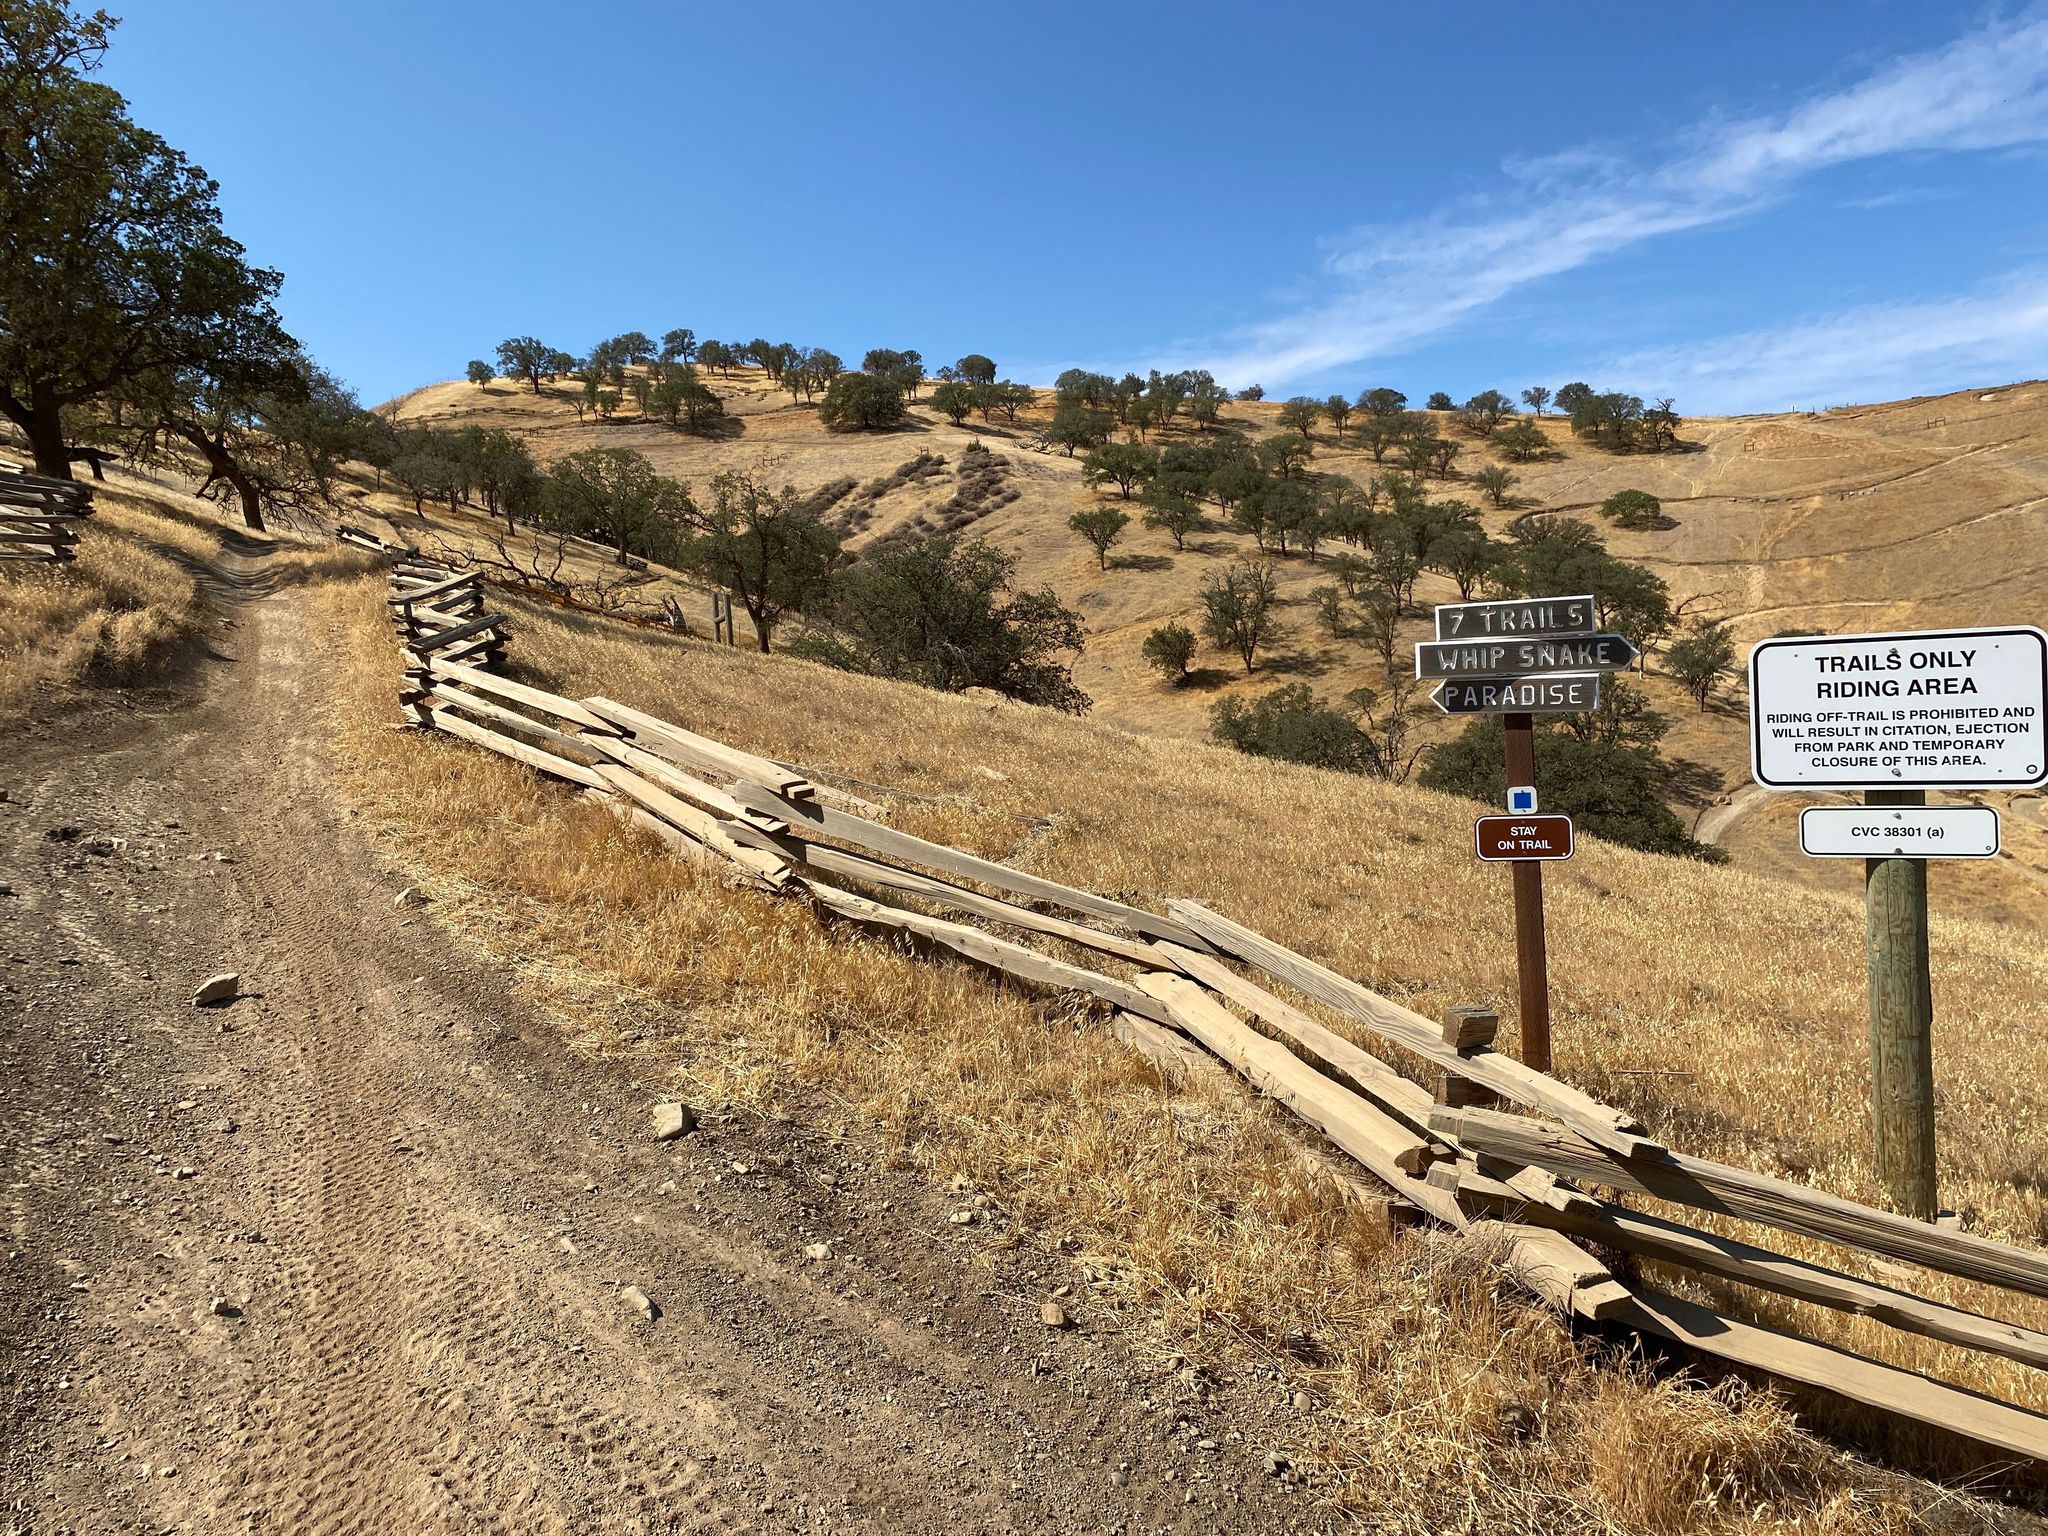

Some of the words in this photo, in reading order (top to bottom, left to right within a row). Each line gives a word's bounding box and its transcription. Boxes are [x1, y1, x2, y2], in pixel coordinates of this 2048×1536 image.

[1449, 612, 1464, 634] 7
[1480, 603, 1584, 632] TRAILS
[1438, 647, 1505, 670] WHIP
[1519, 642, 1611, 667] SNAKE
[1815, 653, 1902, 673] TRAILS
[1910, 650, 1976, 670] ONLY
[1445, 684, 1582, 707] PARADISE
[1817, 680, 1899, 698] RIDING
[1907, 678, 1978, 695] AREA
[1767, 713, 1812, 724] RIDING
[1816, 711, 1888, 722] OFF-TRAIL
[1892, 710, 1905, 721] IS
[1910, 708, 1999, 720] PROHIBITED
[2003, 707, 2035, 718] AND
[1772, 728, 1804, 738] WILL
[1808, 727, 1861, 737] RESULT
[1865, 726, 1878, 736] IN
[1882, 725, 1951, 736] CITATION,
[1956, 723, 2029, 734] EJECTION
[1795, 742, 1833, 752] FROM
[1838, 741, 1875, 752] PARK
[1879, 741, 1908, 751] AND
[1913, 739, 2005, 750] TEMPORARY
[1812, 757, 1878, 767] CLOSURE
[1882, 756, 1901, 766] OF
[1905, 756, 1937, 766] THIS
[1942, 755, 1986, 766] AREA.
[1510, 826, 1537, 836] STAY
[1851, 827, 1880, 837] CVC
[1884, 827, 1922, 837] 38301
[1927, 827, 1944, 839] (a)
[1498, 841, 1514, 850] ON
[1519, 840, 1552, 849] TRAIL
